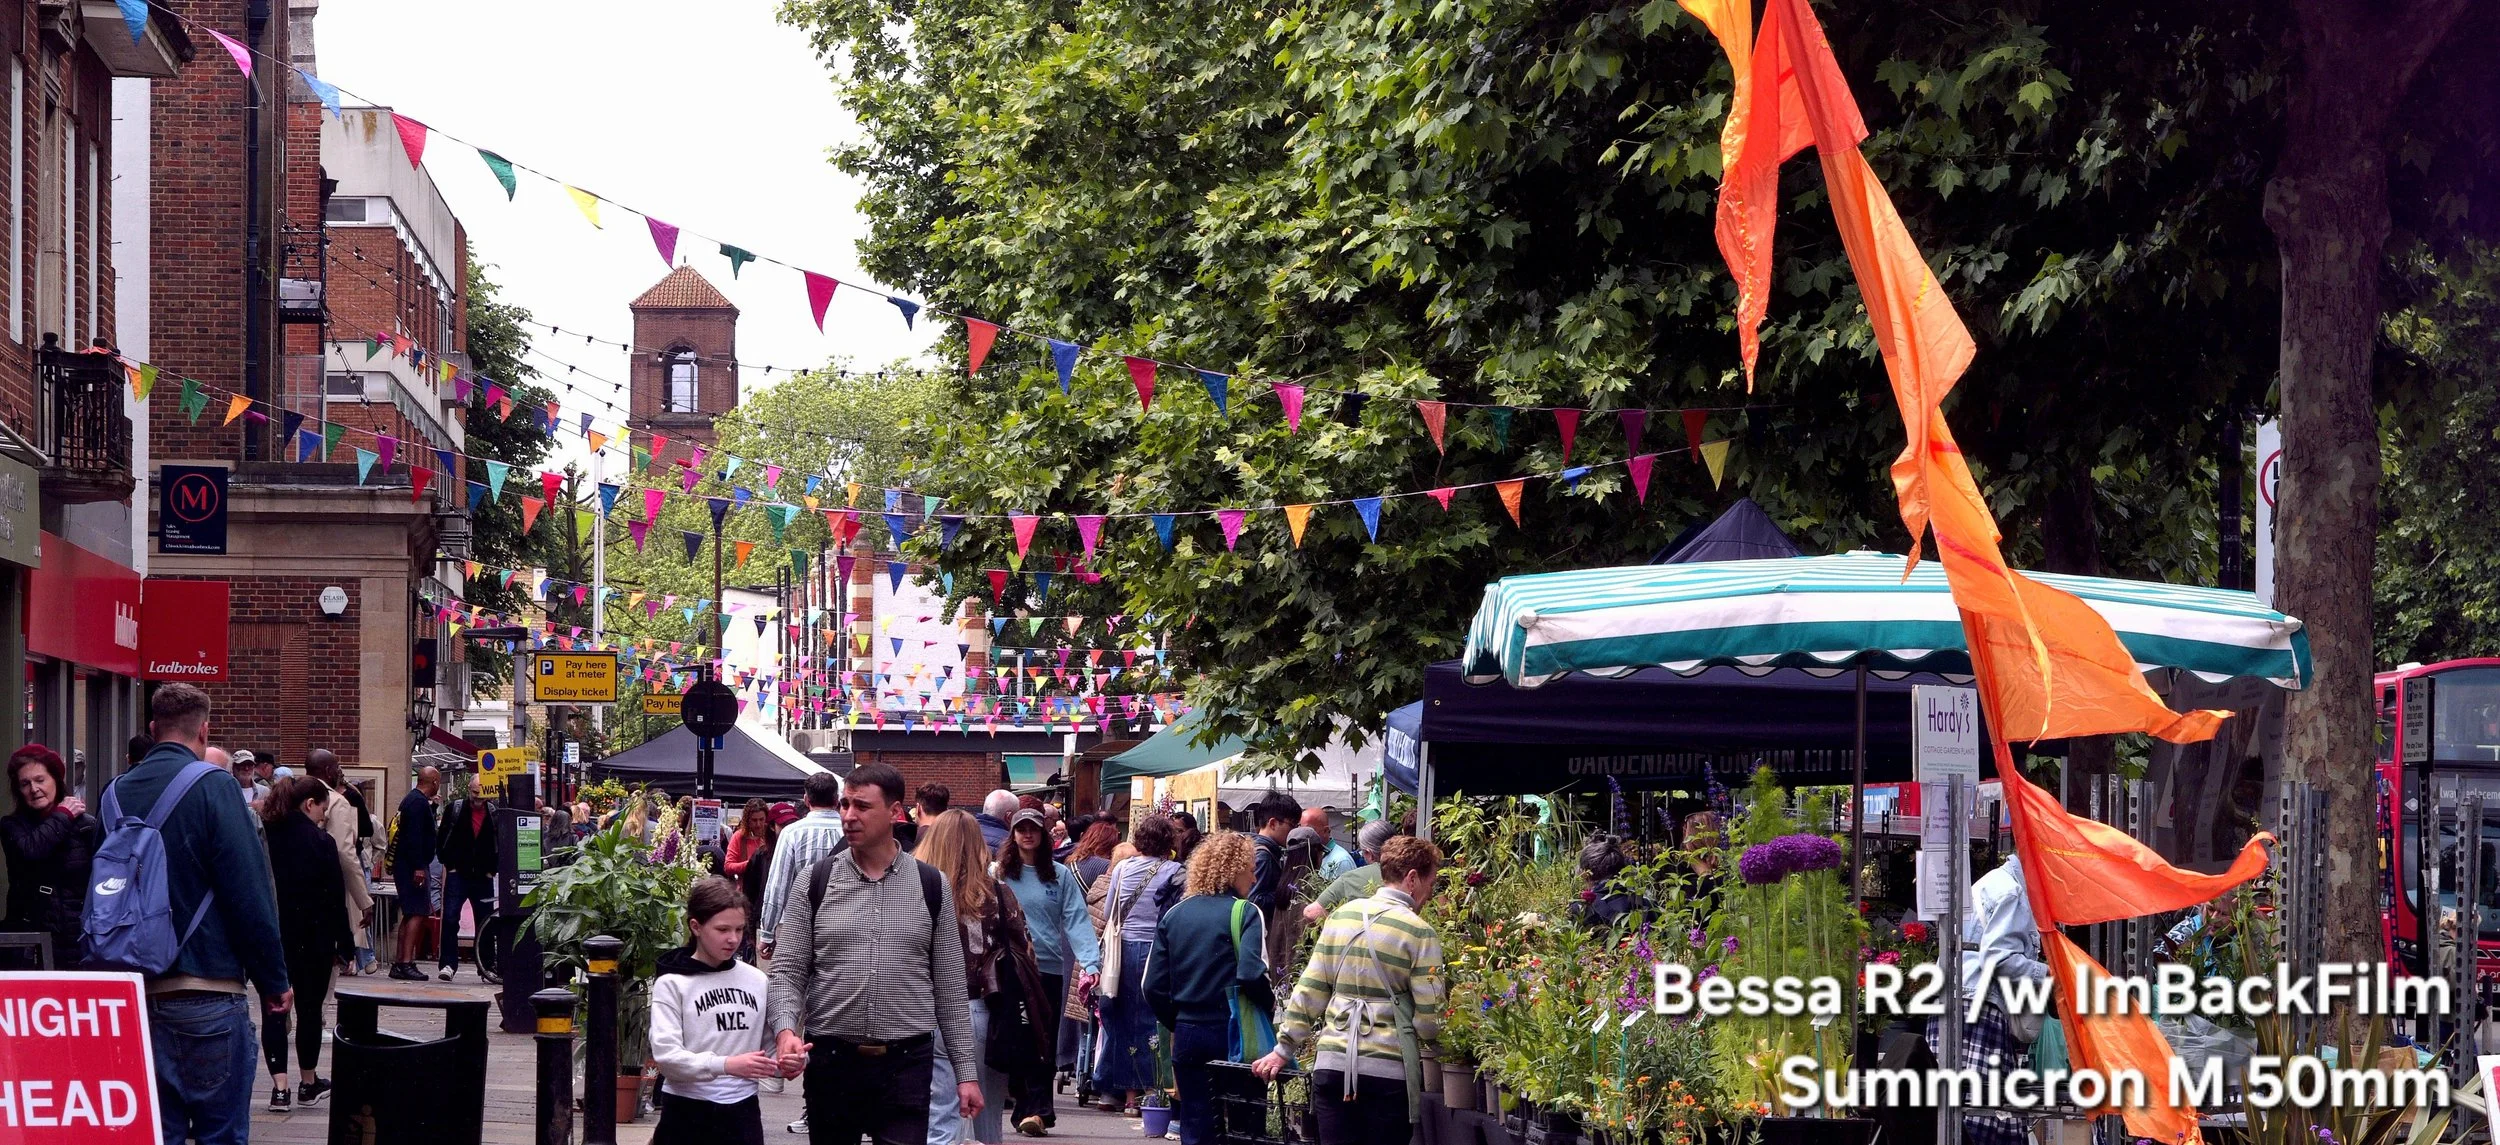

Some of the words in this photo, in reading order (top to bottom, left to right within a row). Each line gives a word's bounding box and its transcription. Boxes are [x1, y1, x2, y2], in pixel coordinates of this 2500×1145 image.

[182, 485, 207, 510] M
[149, 660, 219, 675] Ladbrokes
[565, 660, 583, 670] Pay
[586, 660, 607, 669] here
[565, 670, 575, 678] at
[578, 671, 607, 679] meter
[544, 687, 578, 697] Display
[581, 688, 609, 696] ticket
[646, 698, 665, 710] Pay
[667, 698, 681, 708] he
[694, 987, 759, 1017] MANHATTAN
[715, 1011, 750, 1032] N.Y.C.
[0, 1080, 138, 1127] HEAD
